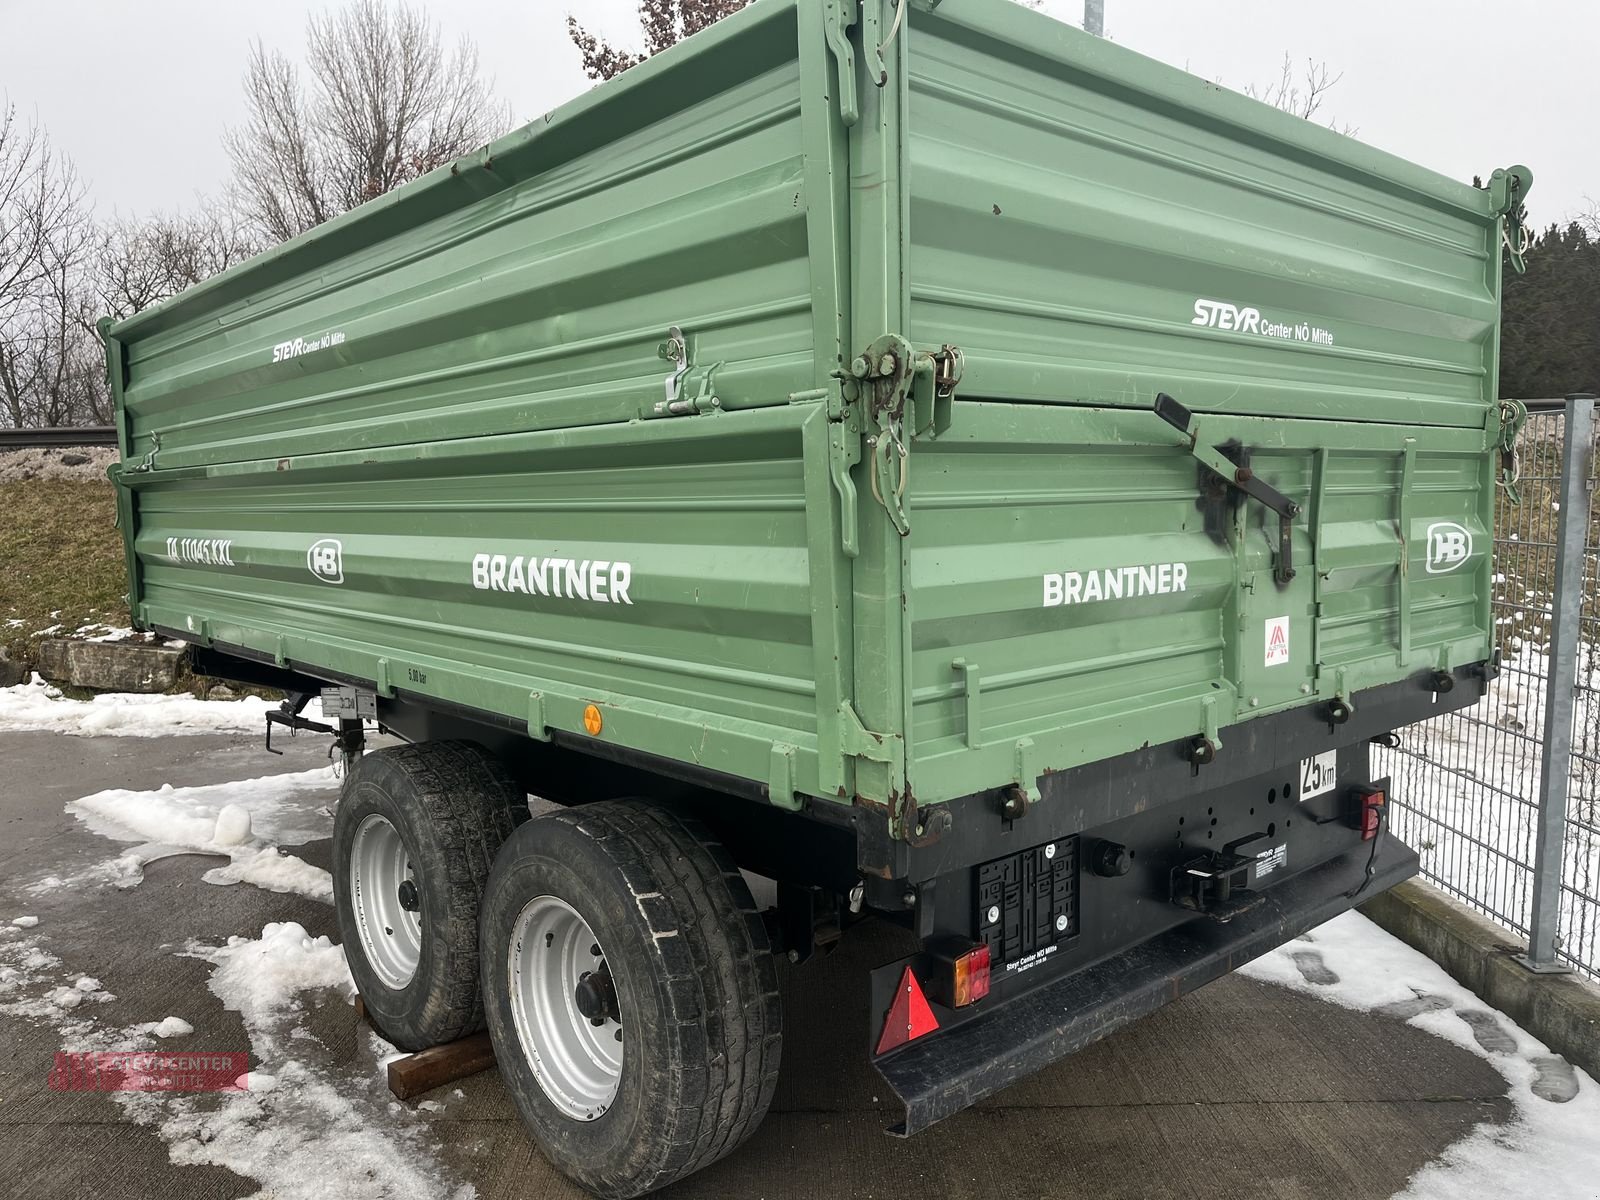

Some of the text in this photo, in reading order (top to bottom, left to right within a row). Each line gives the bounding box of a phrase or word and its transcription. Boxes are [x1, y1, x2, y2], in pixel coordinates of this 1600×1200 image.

[1191, 299, 1334, 346] STEYR Center NÖ Mitte
[272, 332, 346, 363] STEYR Center NÖ Mitte
[166, 537, 236, 567] TA 11045 XXL
[472, 553, 634, 605] BRANTNER
[1043, 562, 1188, 608] BRANTNER
[1302, 756, 1335, 794] 25 km
[1020, 954, 1036, 966] Center
[1045, 945, 1058, 955] Mitte
